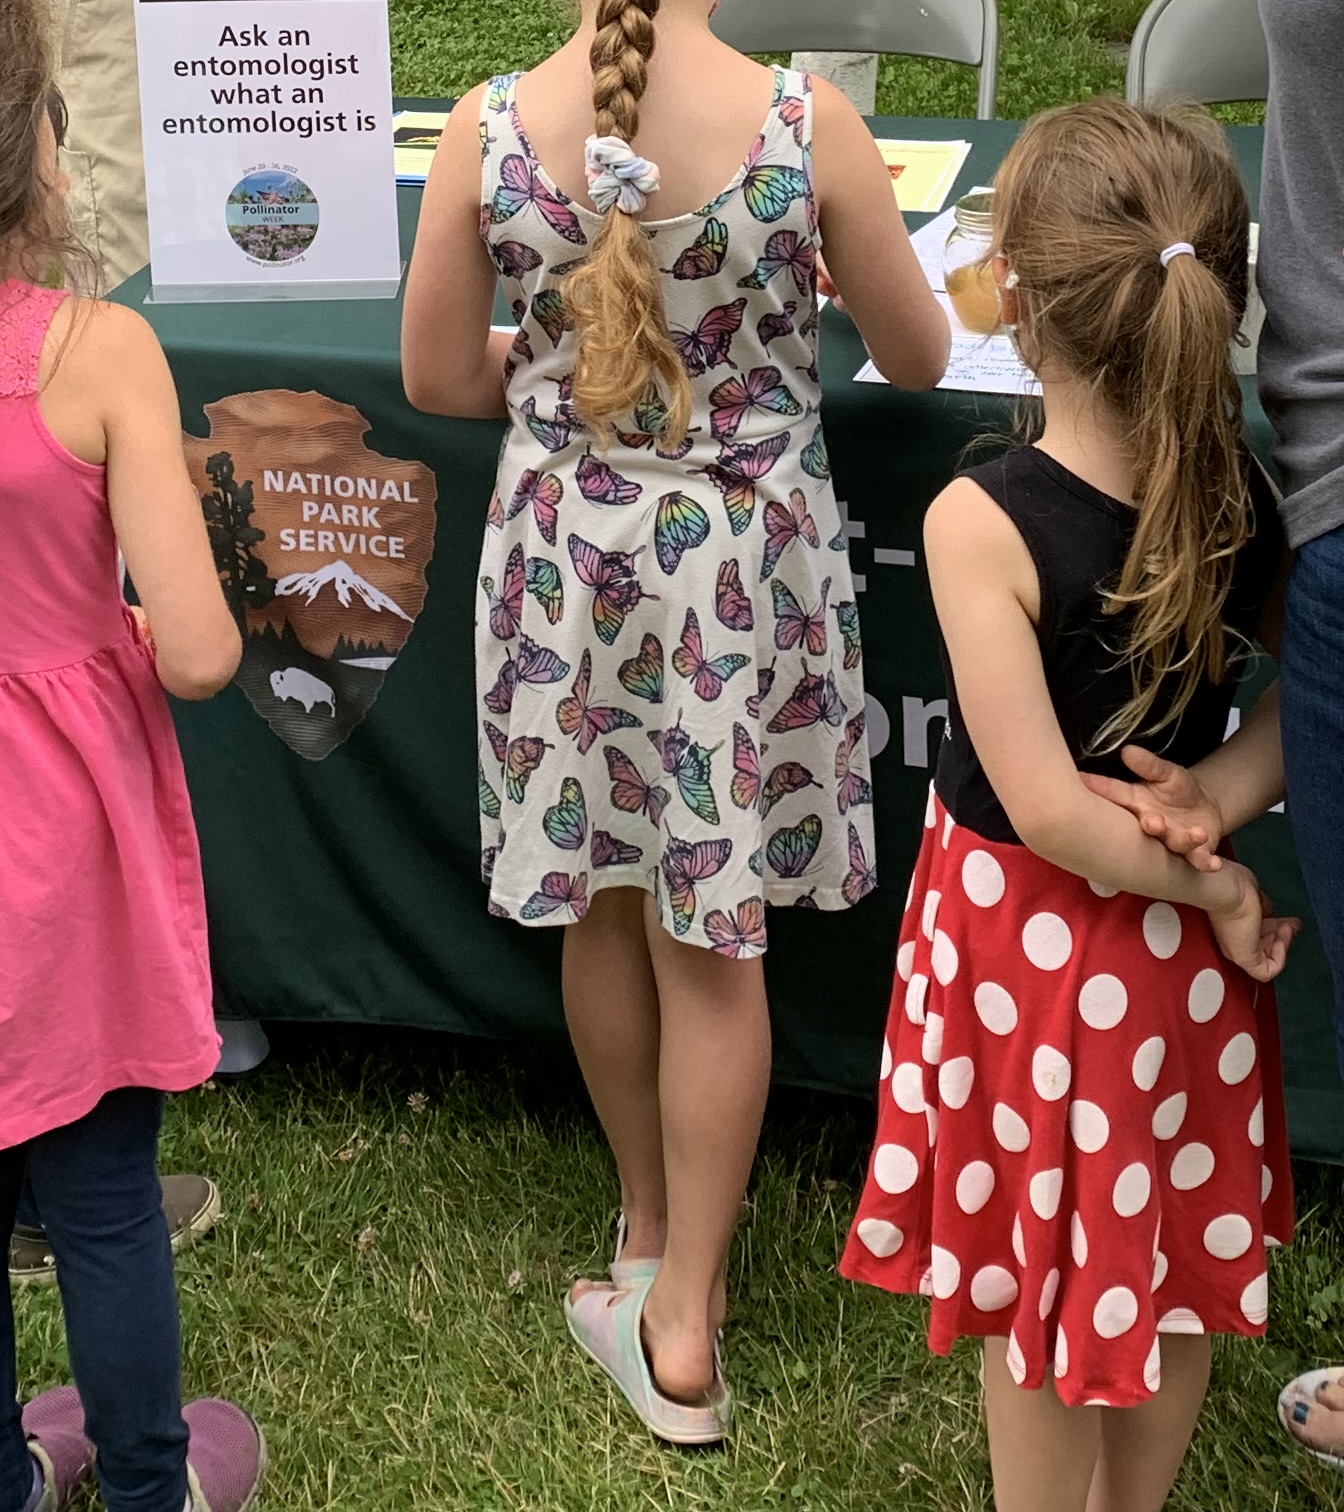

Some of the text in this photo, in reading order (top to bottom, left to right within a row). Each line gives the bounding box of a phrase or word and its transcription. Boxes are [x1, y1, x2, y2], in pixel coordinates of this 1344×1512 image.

[218, 24, 310, 47] Ask an
[173, 52, 359, 81] entomologist
[210, 82, 324, 105] what an
[162, 109, 376, 139] entomologist is
[242, 204, 301, 215] Pollinator
[262, 215, 285, 224] WEEK
[263, 470, 419, 504] NATIONAL
[302, 500, 382, 529] PARK
[279, 529, 406, 559] SERVICE
